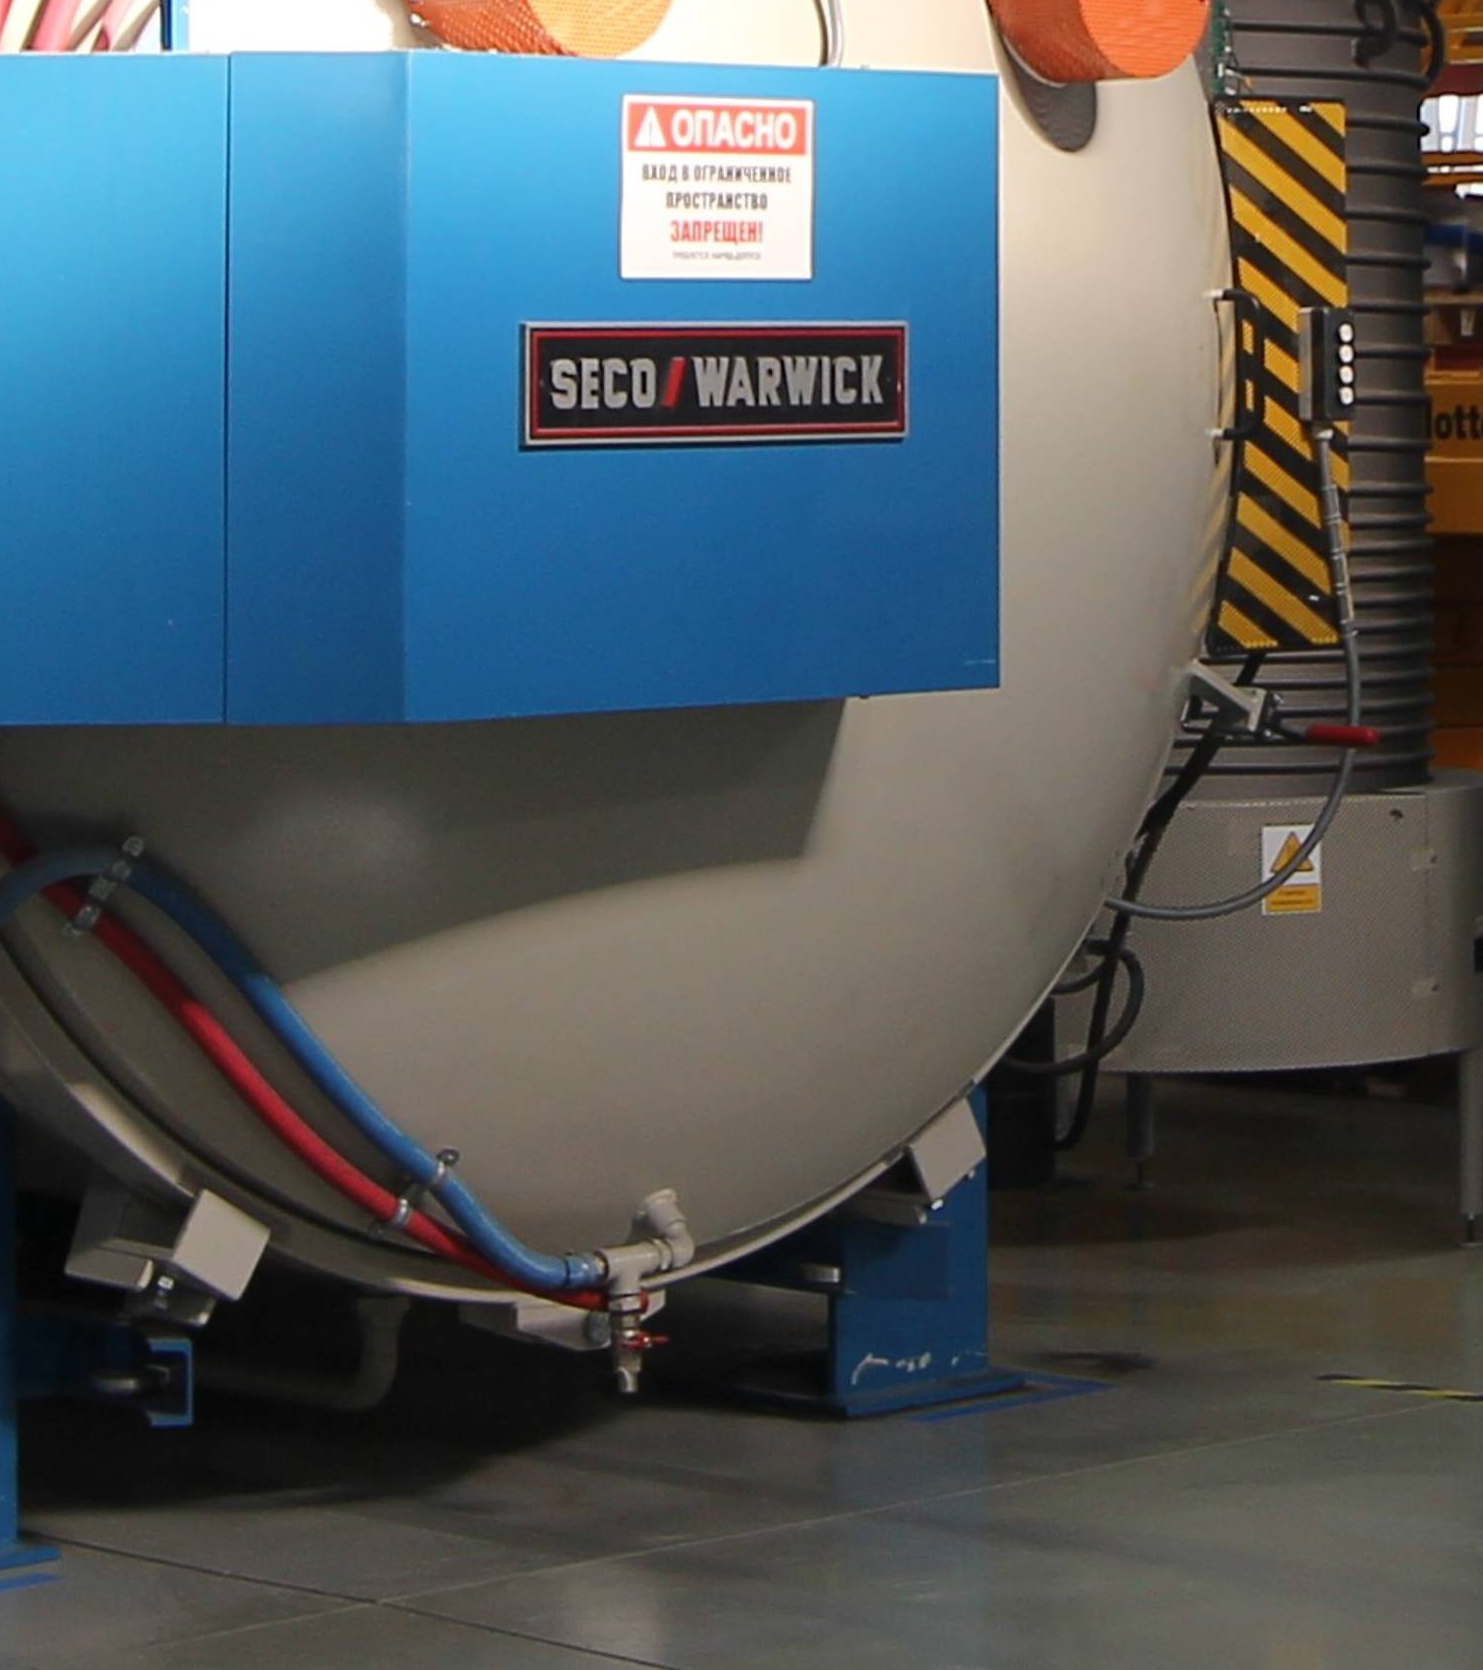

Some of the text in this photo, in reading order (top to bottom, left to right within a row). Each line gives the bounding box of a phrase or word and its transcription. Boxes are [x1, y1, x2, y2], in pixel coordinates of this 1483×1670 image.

[671, 107, 797, 150] ОПАСНО
[642, 164, 792, 184] ВХОД В ОГРАНИЧЕННОЕ
[665, 191, 768, 211] ПРОСТРАНСТВО
[670, 219, 764, 245] ЗАПРЕЩЕН!
